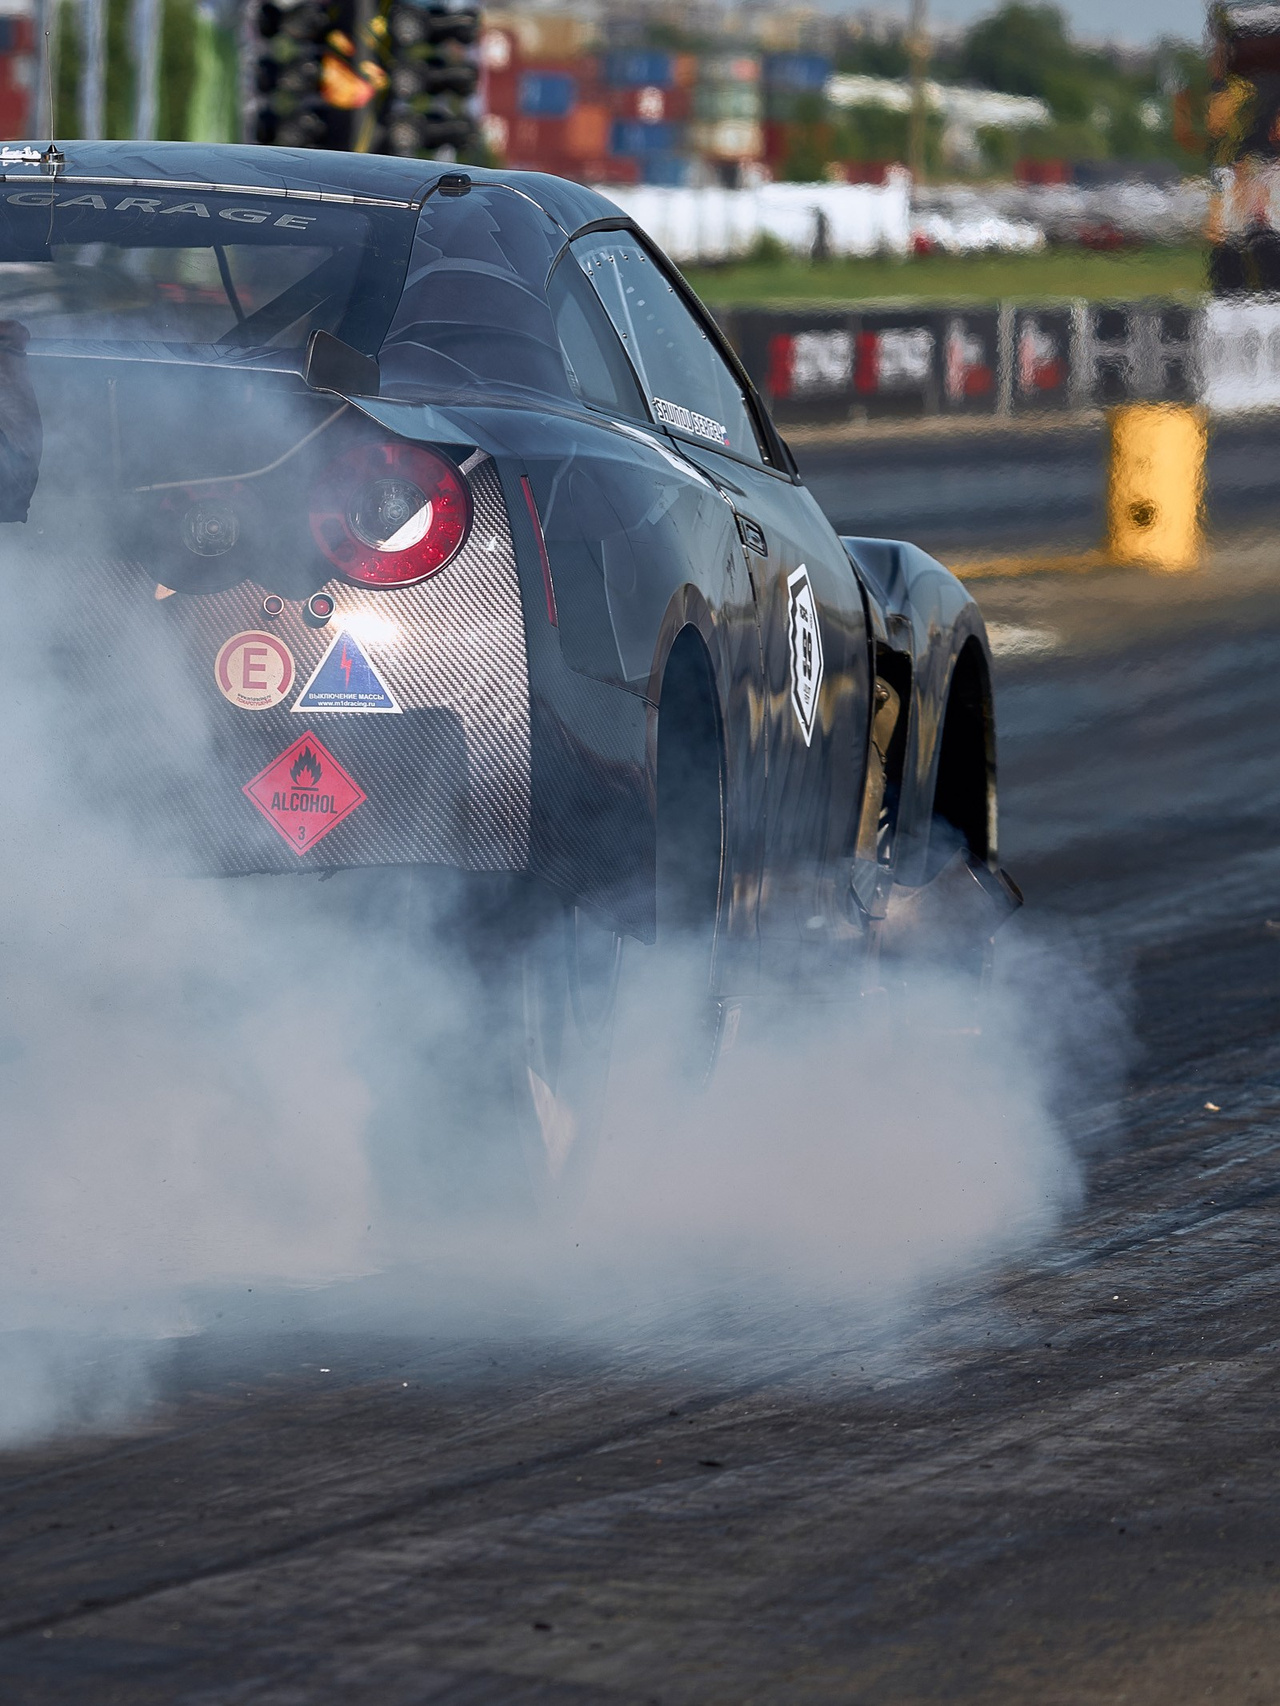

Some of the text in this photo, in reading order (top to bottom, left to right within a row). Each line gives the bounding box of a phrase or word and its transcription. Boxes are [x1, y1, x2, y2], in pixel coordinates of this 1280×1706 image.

[243, 648, 268, 689] E
[271, 792, 338, 815] ALCOHOL
[298, 826, 306, 841] 3
